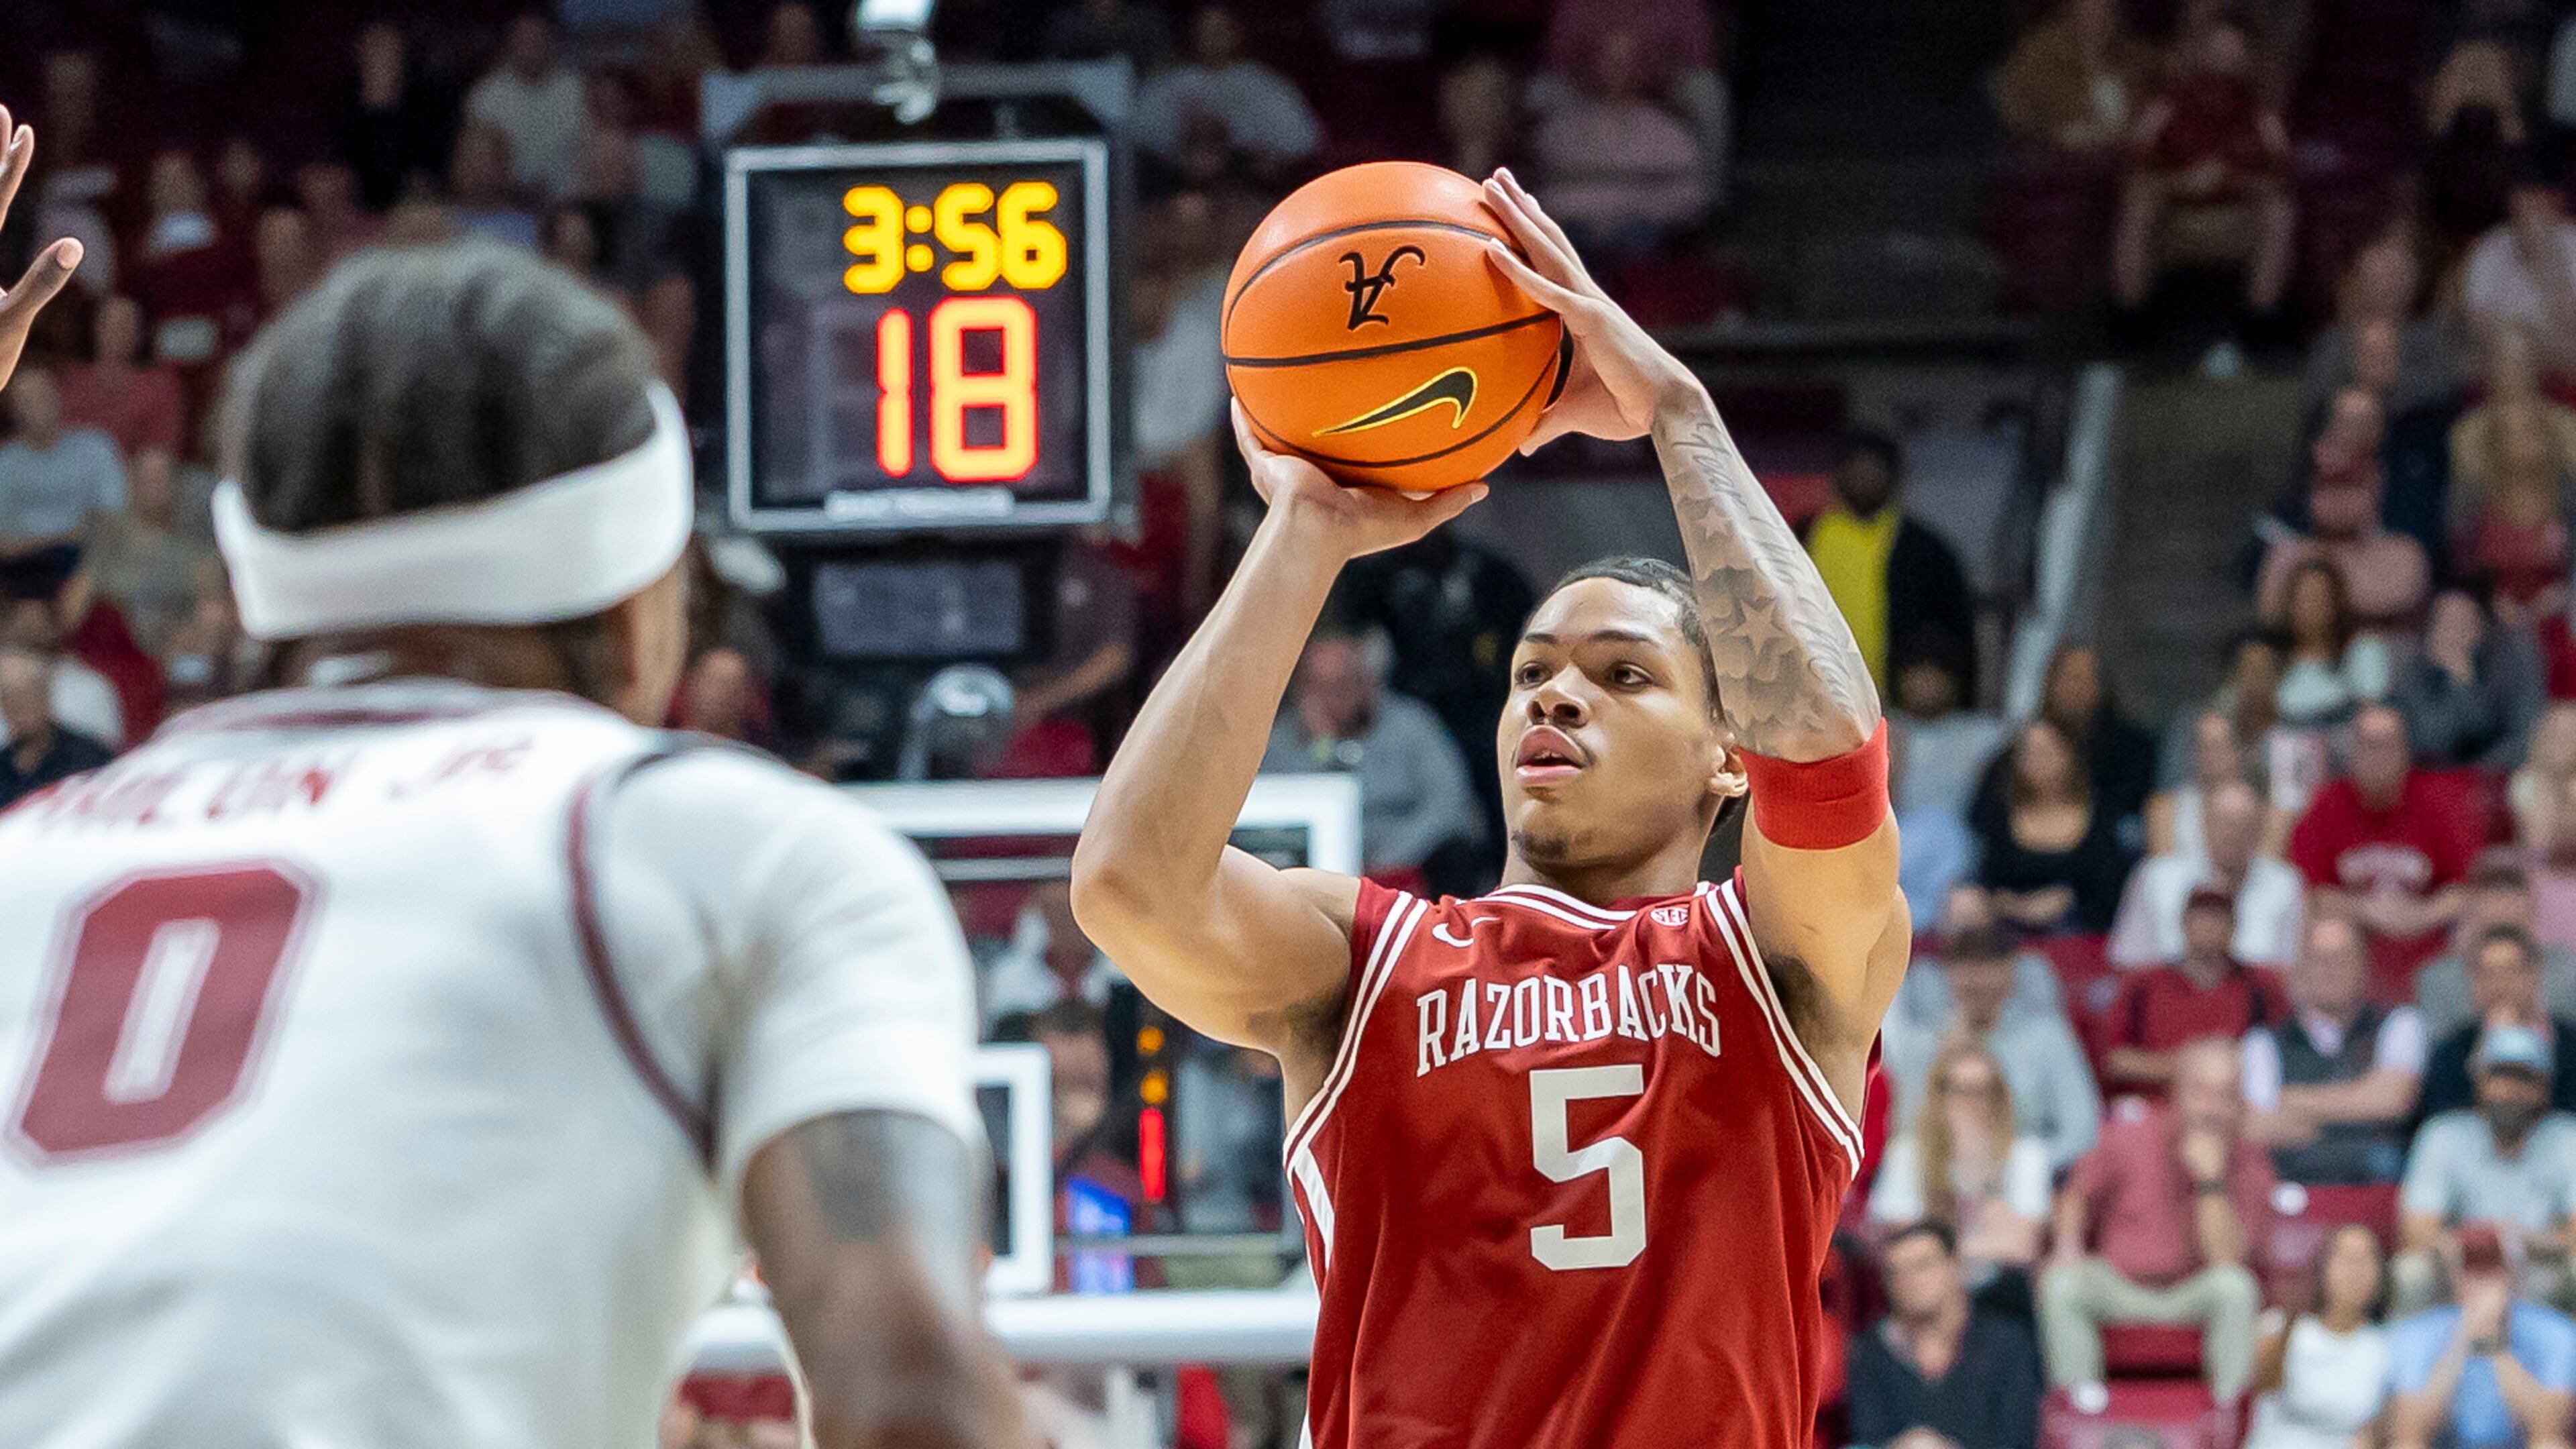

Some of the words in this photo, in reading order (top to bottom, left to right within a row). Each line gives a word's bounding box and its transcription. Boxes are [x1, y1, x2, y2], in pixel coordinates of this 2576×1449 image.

[843, 181, 1067, 294] 3:56
[876, 296, 1038, 482] 18
[1651, 907, 1688, 926] SEC
[8, 859, 323, 1164] 0
[1416, 963, 1722, 1078] RAZORBACKS
[1529, 1063, 1648, 1271] 5
